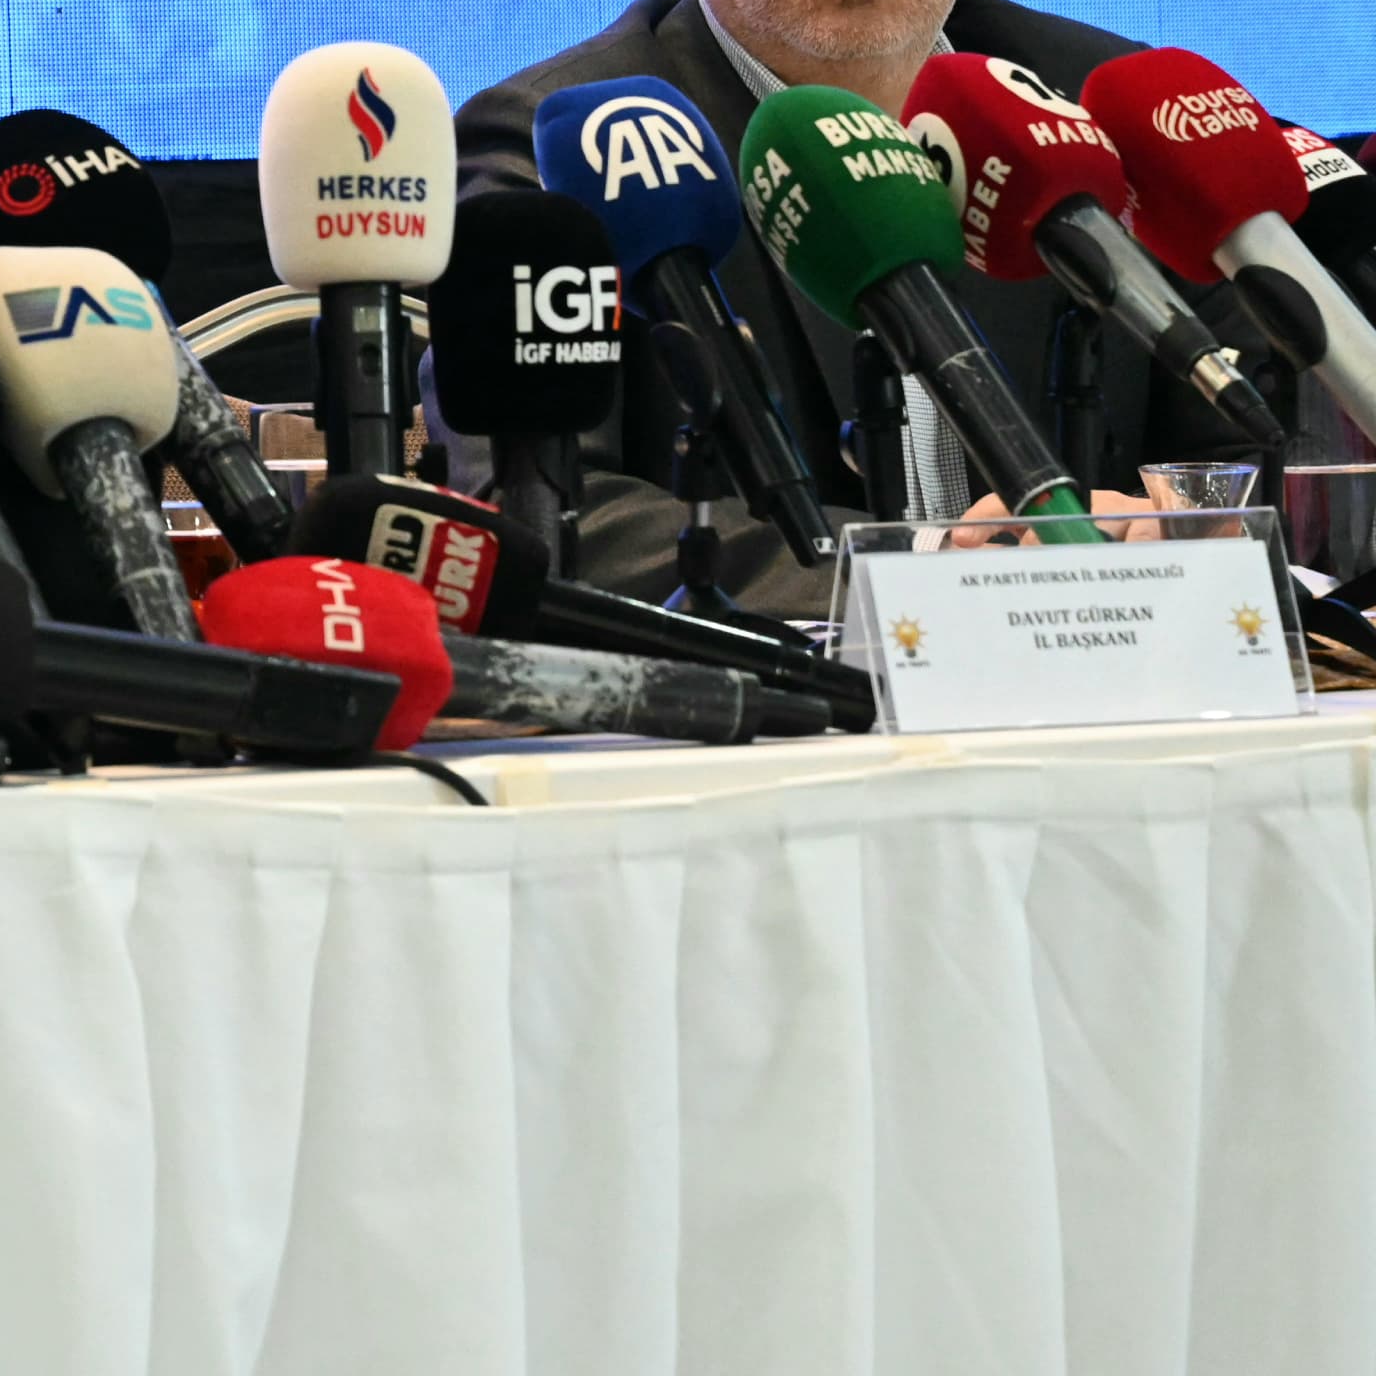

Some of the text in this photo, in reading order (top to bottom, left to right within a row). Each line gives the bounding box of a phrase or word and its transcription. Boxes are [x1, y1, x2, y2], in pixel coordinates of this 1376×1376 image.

[1177, 87, 1255, 114] bursa
[1189, 103, 1259, 138] takip
[44, 146, 141, 187] İHA
[604, 115, 717, 201] AA
[318, 175, 427, 202] HERKES
[316, 211, 426, 240] DUYSUN
[960, 564, 1185, 587] AK PARTİ BURSA İL BAŞKANLIĞI
[310, 559, 365, 653] DHA
[1007, 604, 1155, 627] DAVUT GÜRKAN
[1034, 630, 1138, 652] İL BAŞKANI
